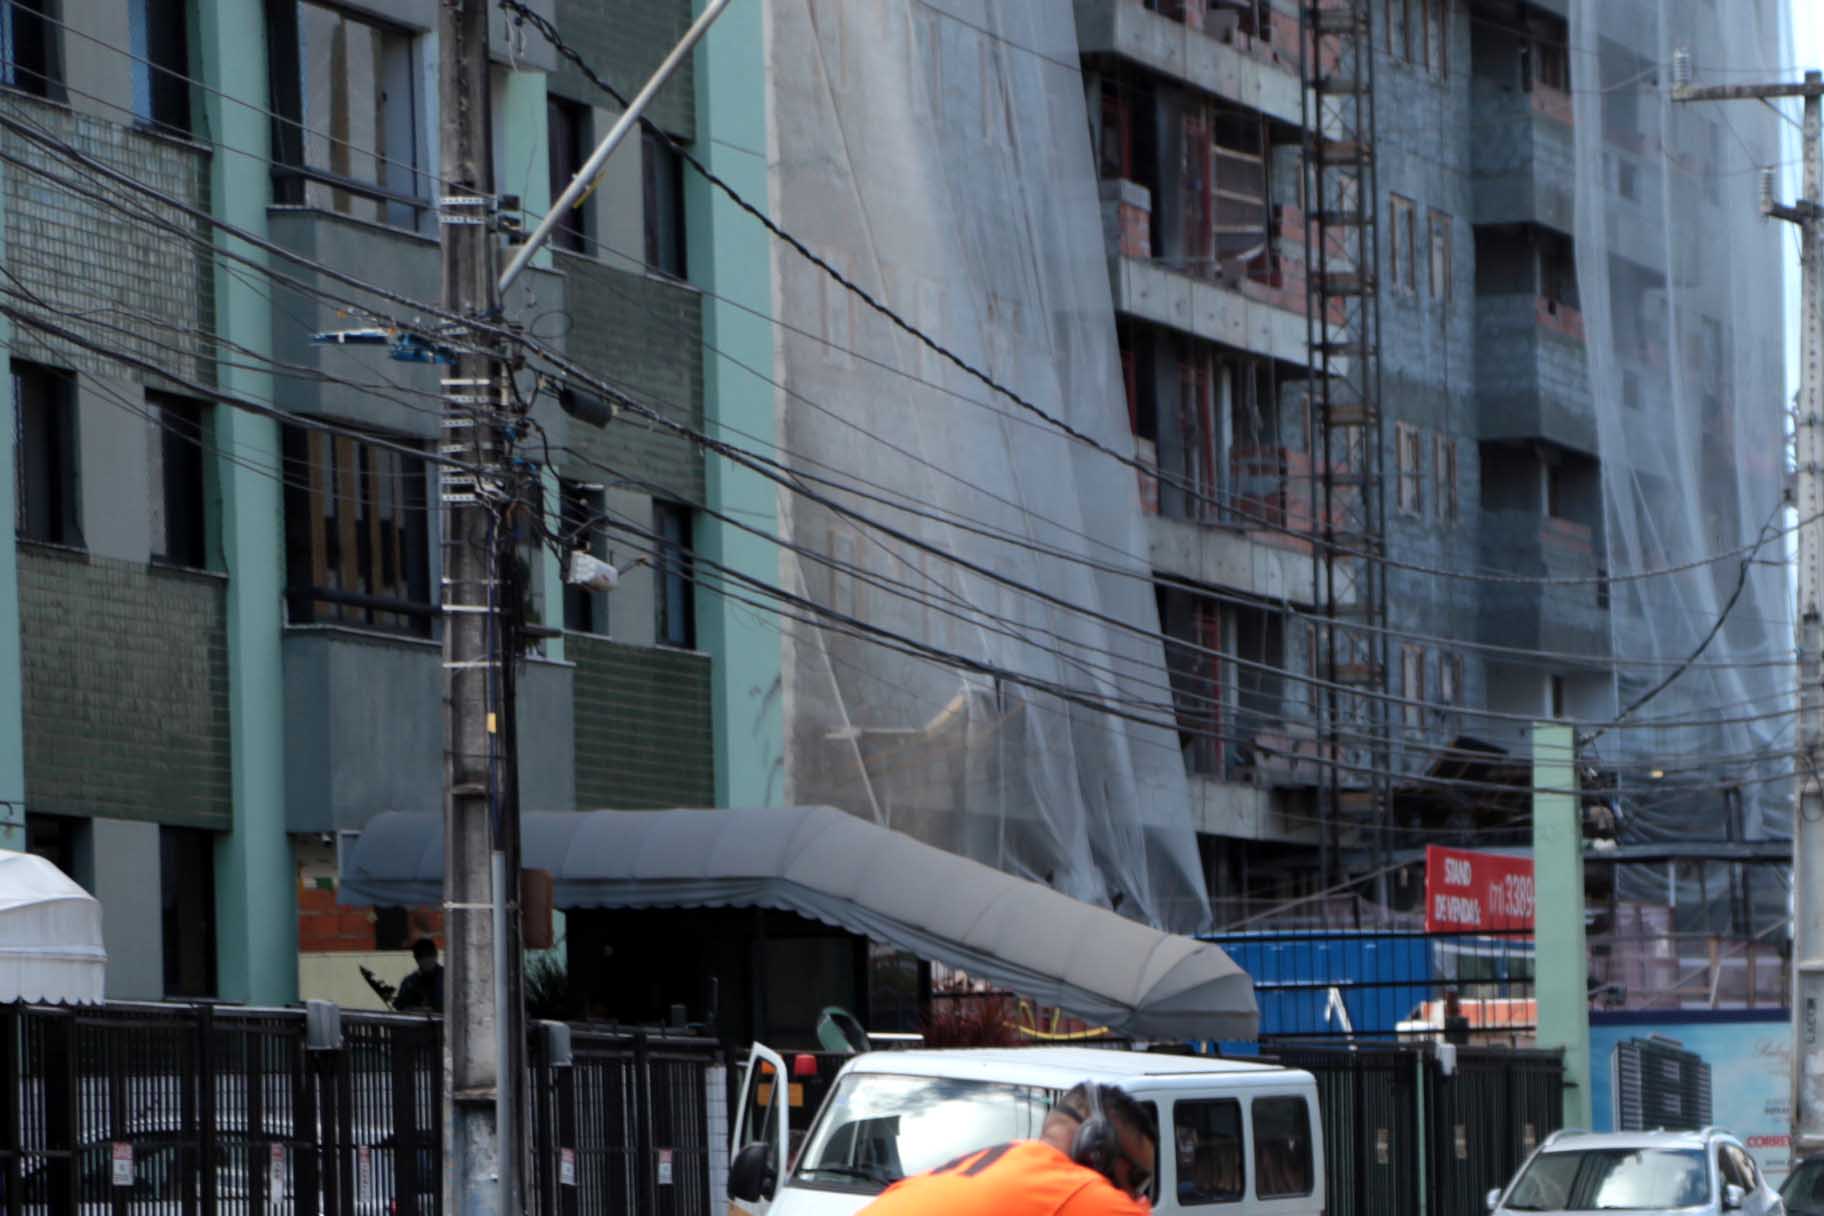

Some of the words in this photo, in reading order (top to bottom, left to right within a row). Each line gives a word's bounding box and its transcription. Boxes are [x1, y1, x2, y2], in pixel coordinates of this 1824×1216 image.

[1444, 857, 1471, 887] STAND
[1434, 894, 1447, 921] DE
[1746, 1135, 1792, 1148] CORRET
